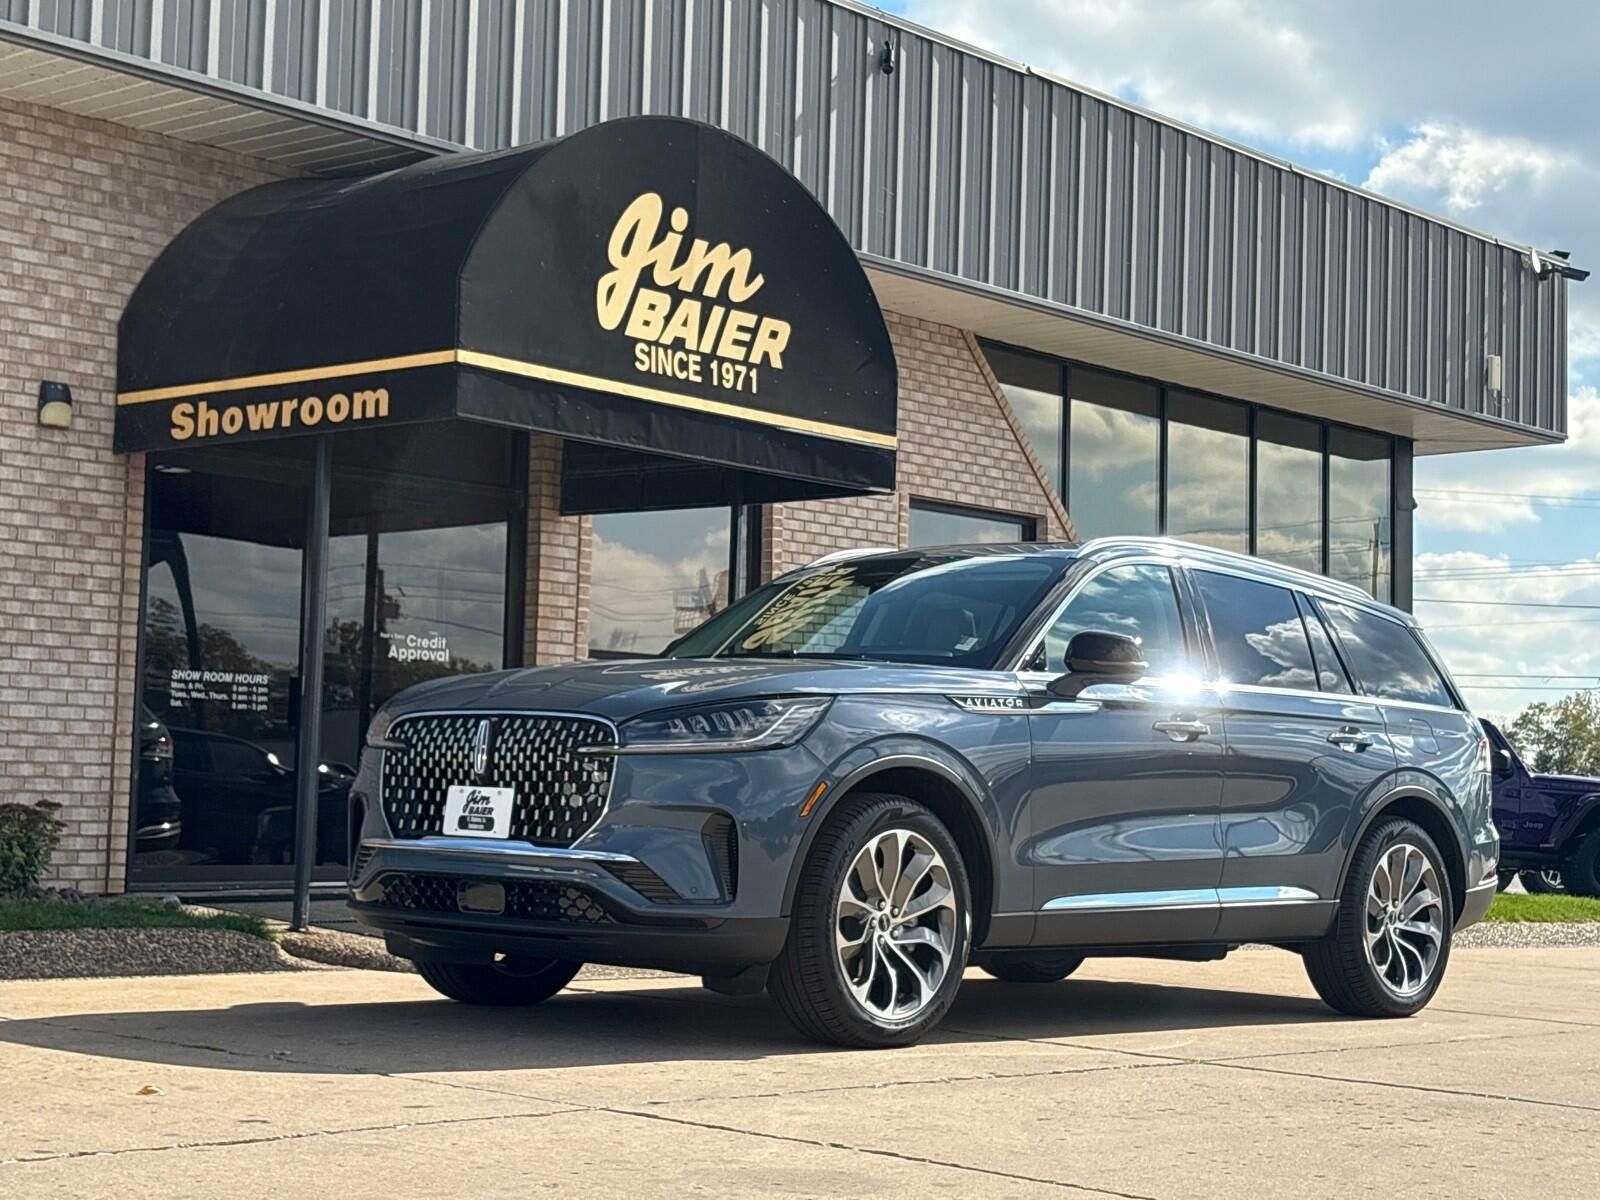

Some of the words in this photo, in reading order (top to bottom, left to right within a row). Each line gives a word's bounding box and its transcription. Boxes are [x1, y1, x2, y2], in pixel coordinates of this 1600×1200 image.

[597, 192, 765, 331] Jim
[624, 287, 791, 369] BAIER
[634, 342, 702, 383] SINCE
[710, 359, 758, 394] 1971
[170, 388, 389, 440] Showroom
[407, 634, 446, 649] Credit
[388, 644, 449, 662] Approval
[171, 669, 201, 680] SHOW
[203, 671, 233, 682] ROOM
[235, 673, 269, 684] HOURS
[966, 698, 1024, 708] AVIATOR
[462, 789, 491, 814] Jim
[468, 806, 494, 815] BAIER
